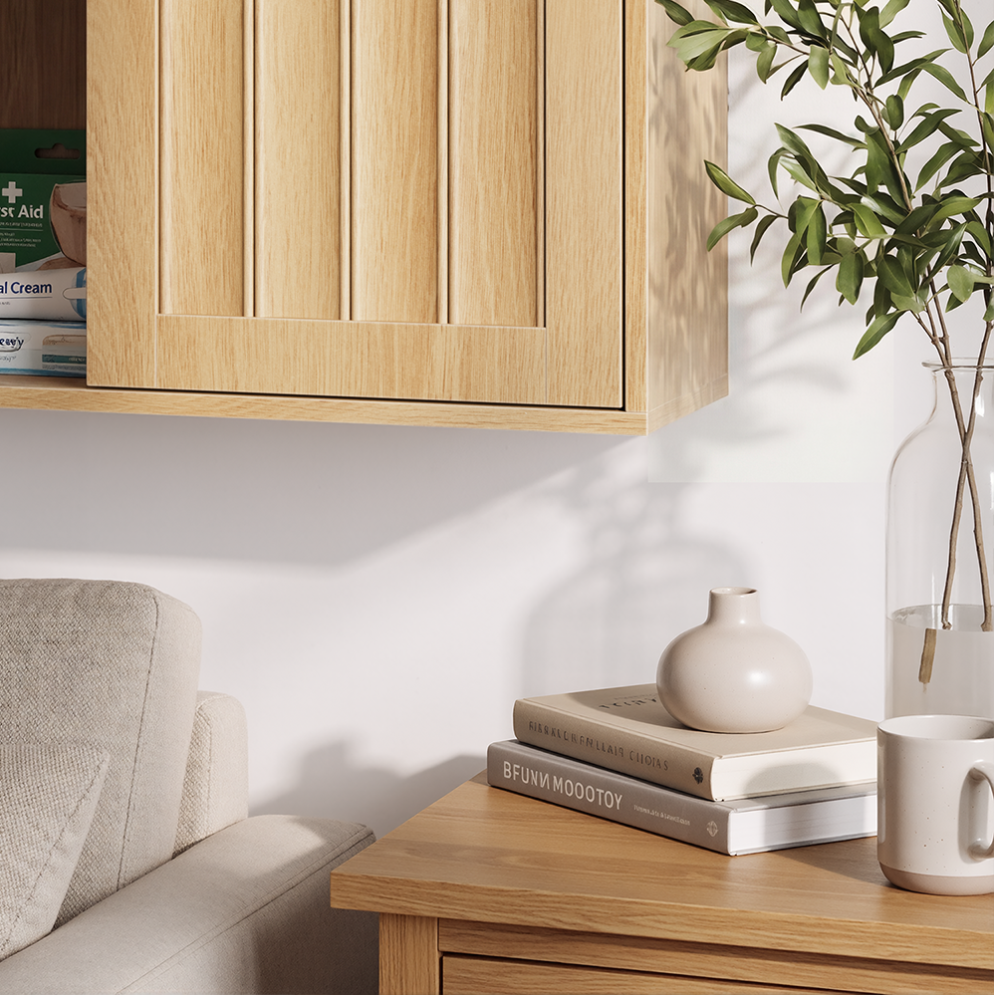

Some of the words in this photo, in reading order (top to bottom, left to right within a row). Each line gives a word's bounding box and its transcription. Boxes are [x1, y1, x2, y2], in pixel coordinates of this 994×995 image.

[17, 204, 44, 219] Aid
[10, 281, 52, 294] Cream
[552, 775, 623, 810] MOOOTOY
